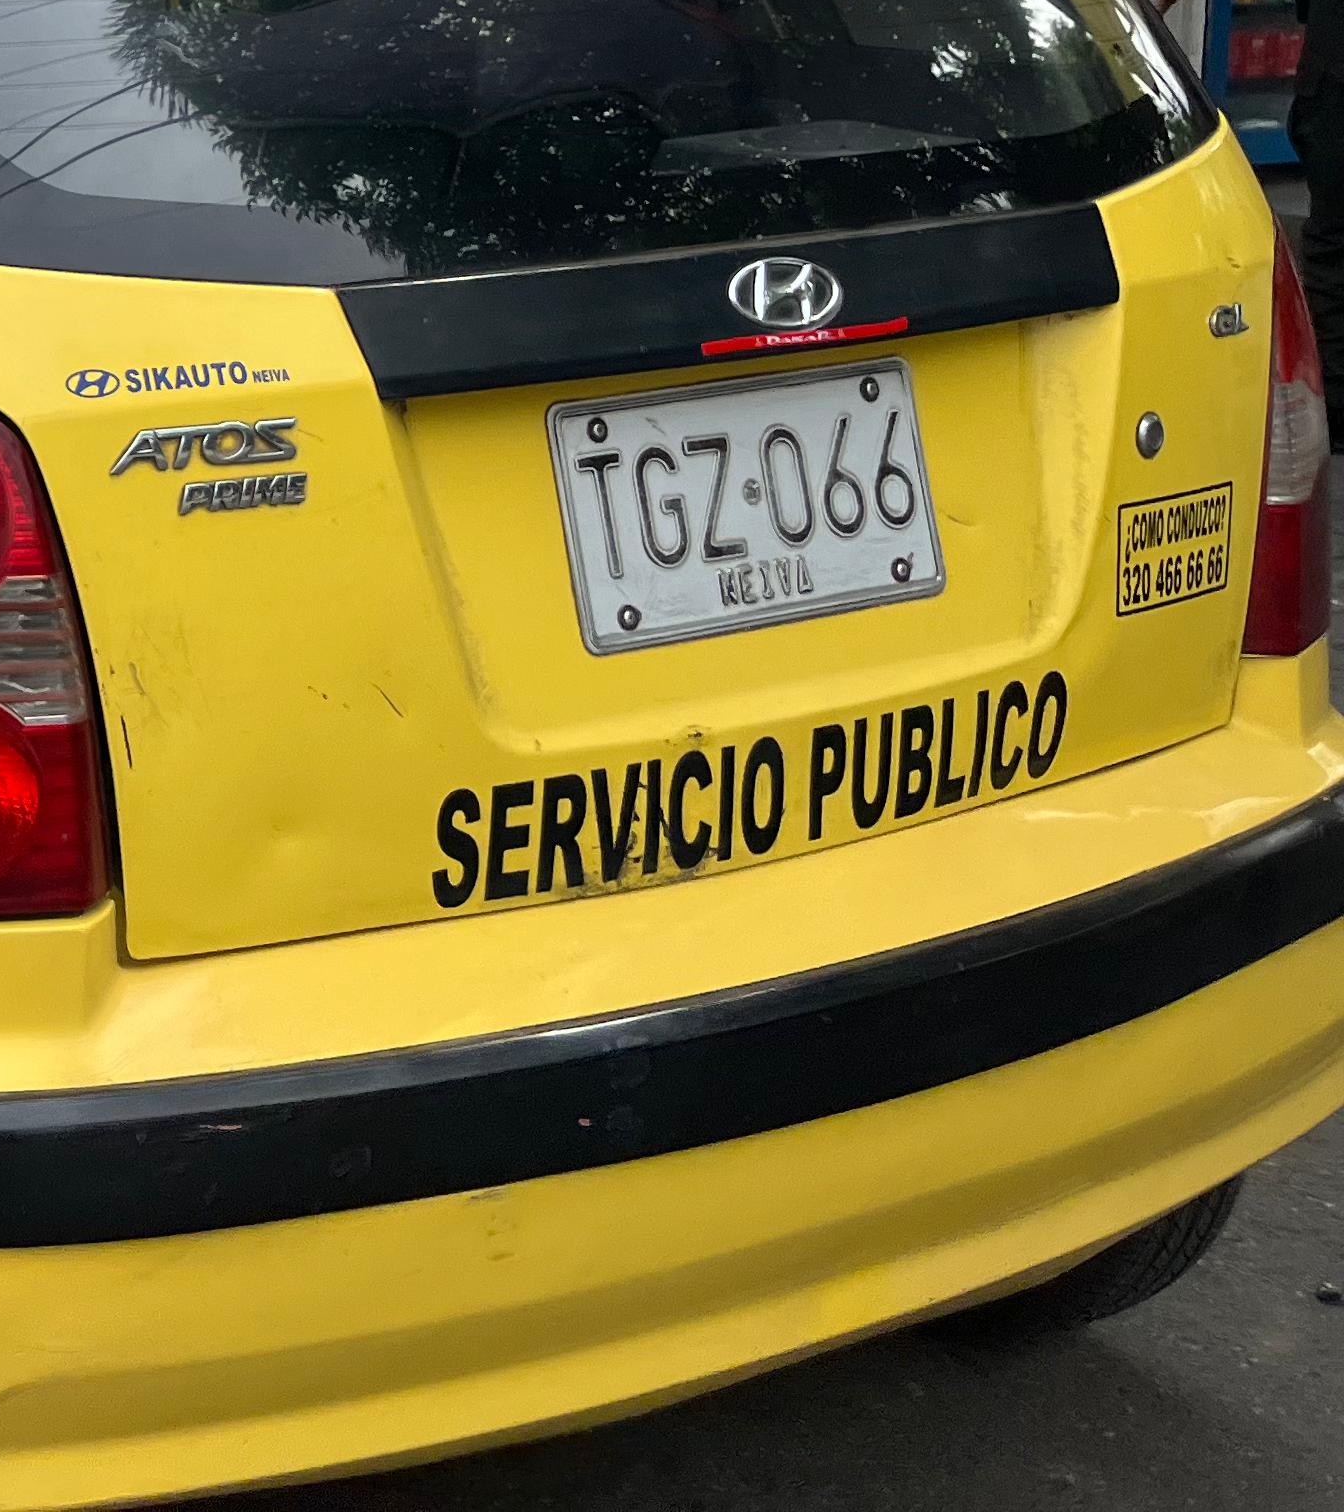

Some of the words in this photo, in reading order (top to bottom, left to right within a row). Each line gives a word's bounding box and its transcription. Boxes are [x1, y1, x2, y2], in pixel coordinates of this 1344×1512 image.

[125, 360, 249, 394] SIKAUTO
[252, 367, 291, 384] NEIVA
[109, 416, 298, 477] ATOS
[177, 471, 309, 517] PRIME
[1124, 508, 1164, 564] ¿COMO
[1166, 493, 1227, 547] CONDUZCO?
[715, 554, 815, 608] NEIVA
[1122, 561, 1151, 607] 320
[1155, 554, 1183, 599] 466
[1186, 547, 1204, 588] 66
[1207, 543, 1224, 583] 66
[431, 735, 785, 909] SERVICIO
[806, 669, 1070, 842] PUBLICO
